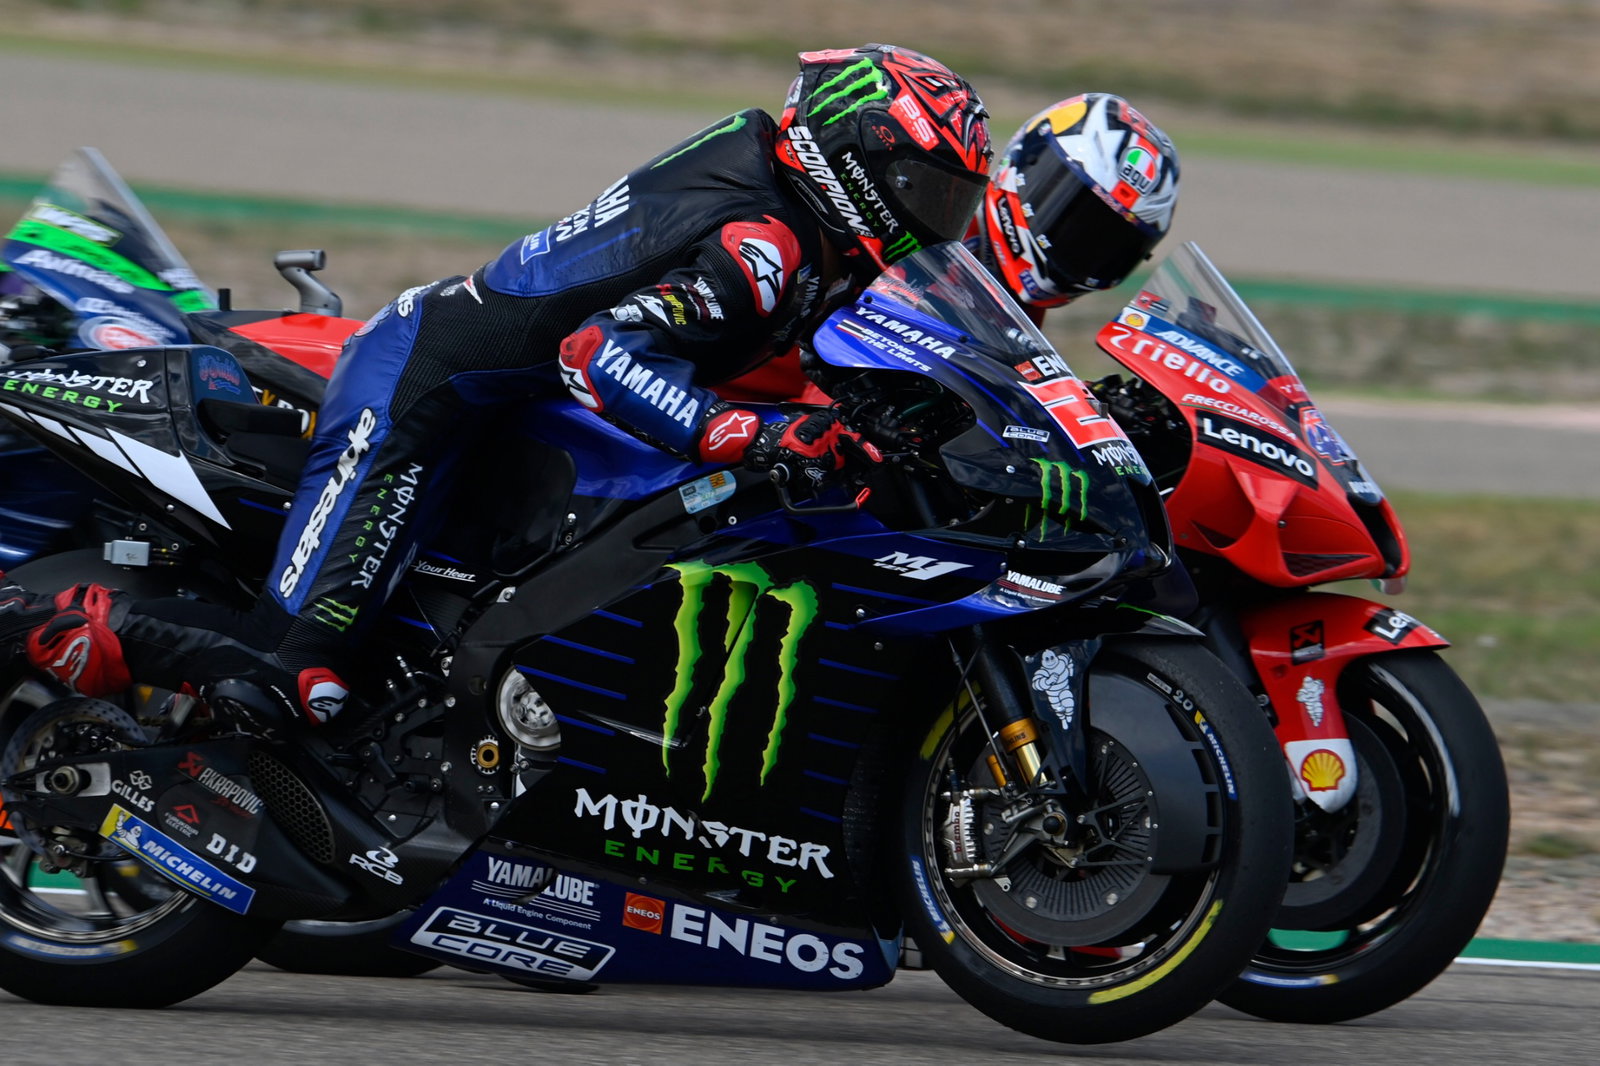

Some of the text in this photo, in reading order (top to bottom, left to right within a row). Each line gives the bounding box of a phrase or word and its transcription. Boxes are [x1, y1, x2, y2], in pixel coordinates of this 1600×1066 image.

[899, 94, 935, 143] BS
[787, 125, 872, 232] SCORPION
[840, 173, 880, 227] ENERGY
[842, 152, 899, 234] MONSTER
[855, 307, 957, 360] YAMAHA
[862, 328, 915, 356] BEYOND
[863, 336, 932, 372] THE LIMITS
[1154, 331, 1245, 377] ADVANCE
[596, 339, 700, 429] YAMAHA
[1132, 340, 1231, 393] riello
[3, 380, 123, 413] ENERGY
[1181, 393, 1297, 441] FRECCIAROSSA
[1202, 417, 1315, 477] Lenovo
[348, 473, 394, 563] ENERGY
[351, 462, 423, 589] MONSTER
[415, 560, 476, 580] Your Heart
[1007, 570, 1064, 595] YAMALUBE
[1173, 690, 1194, 711] 20
[1207, 733, 1235, 794] MICHELIN
[111, 779, 156, 813] GILLES
[574, 788, 834, 879] MONSTER
[142, 840, 238, 899] MICHELIN
[349, 854, 404, 886] RCB
[604, 839, 797, 893] ENERGY
[447, 914, 592, 959] BLUE
[491, 899, 516, 912] Liquid
[517, 905, 544, 919] Engine
[545, 913, 592, 930] Component
[626, 905, 661, 920] ENEOS
[431, 934, 575, 977] CORE
[671, 903, 865, 980] ENEOS
